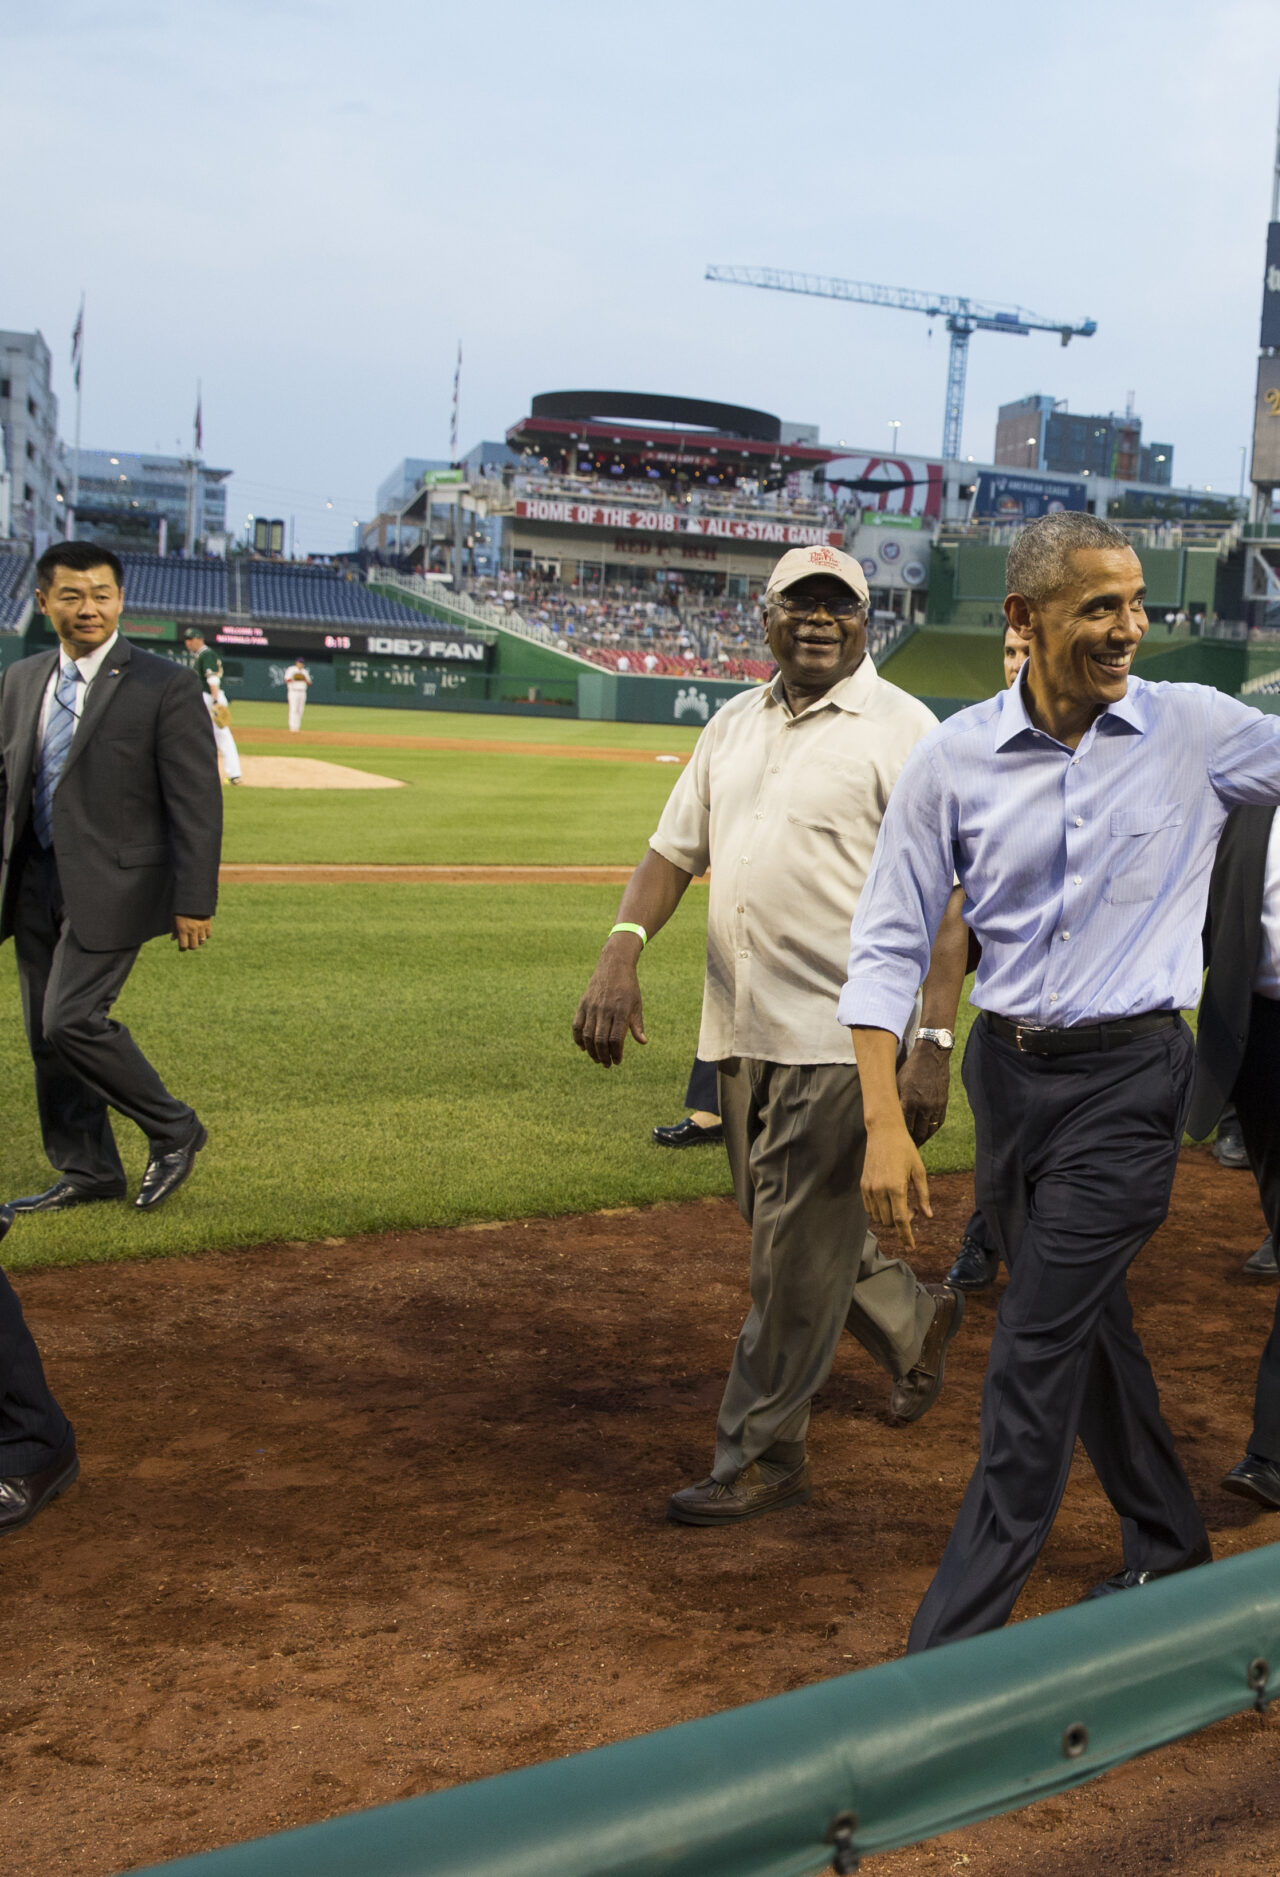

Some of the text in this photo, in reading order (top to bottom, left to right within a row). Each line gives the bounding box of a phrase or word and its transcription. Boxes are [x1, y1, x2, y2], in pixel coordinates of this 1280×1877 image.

[526, 501, 830, 546] HOME OF THE 2018 ALL STAR GAME
[324, 635, 351, 649] 8:15
[428, 641, 484, 660] FAN
